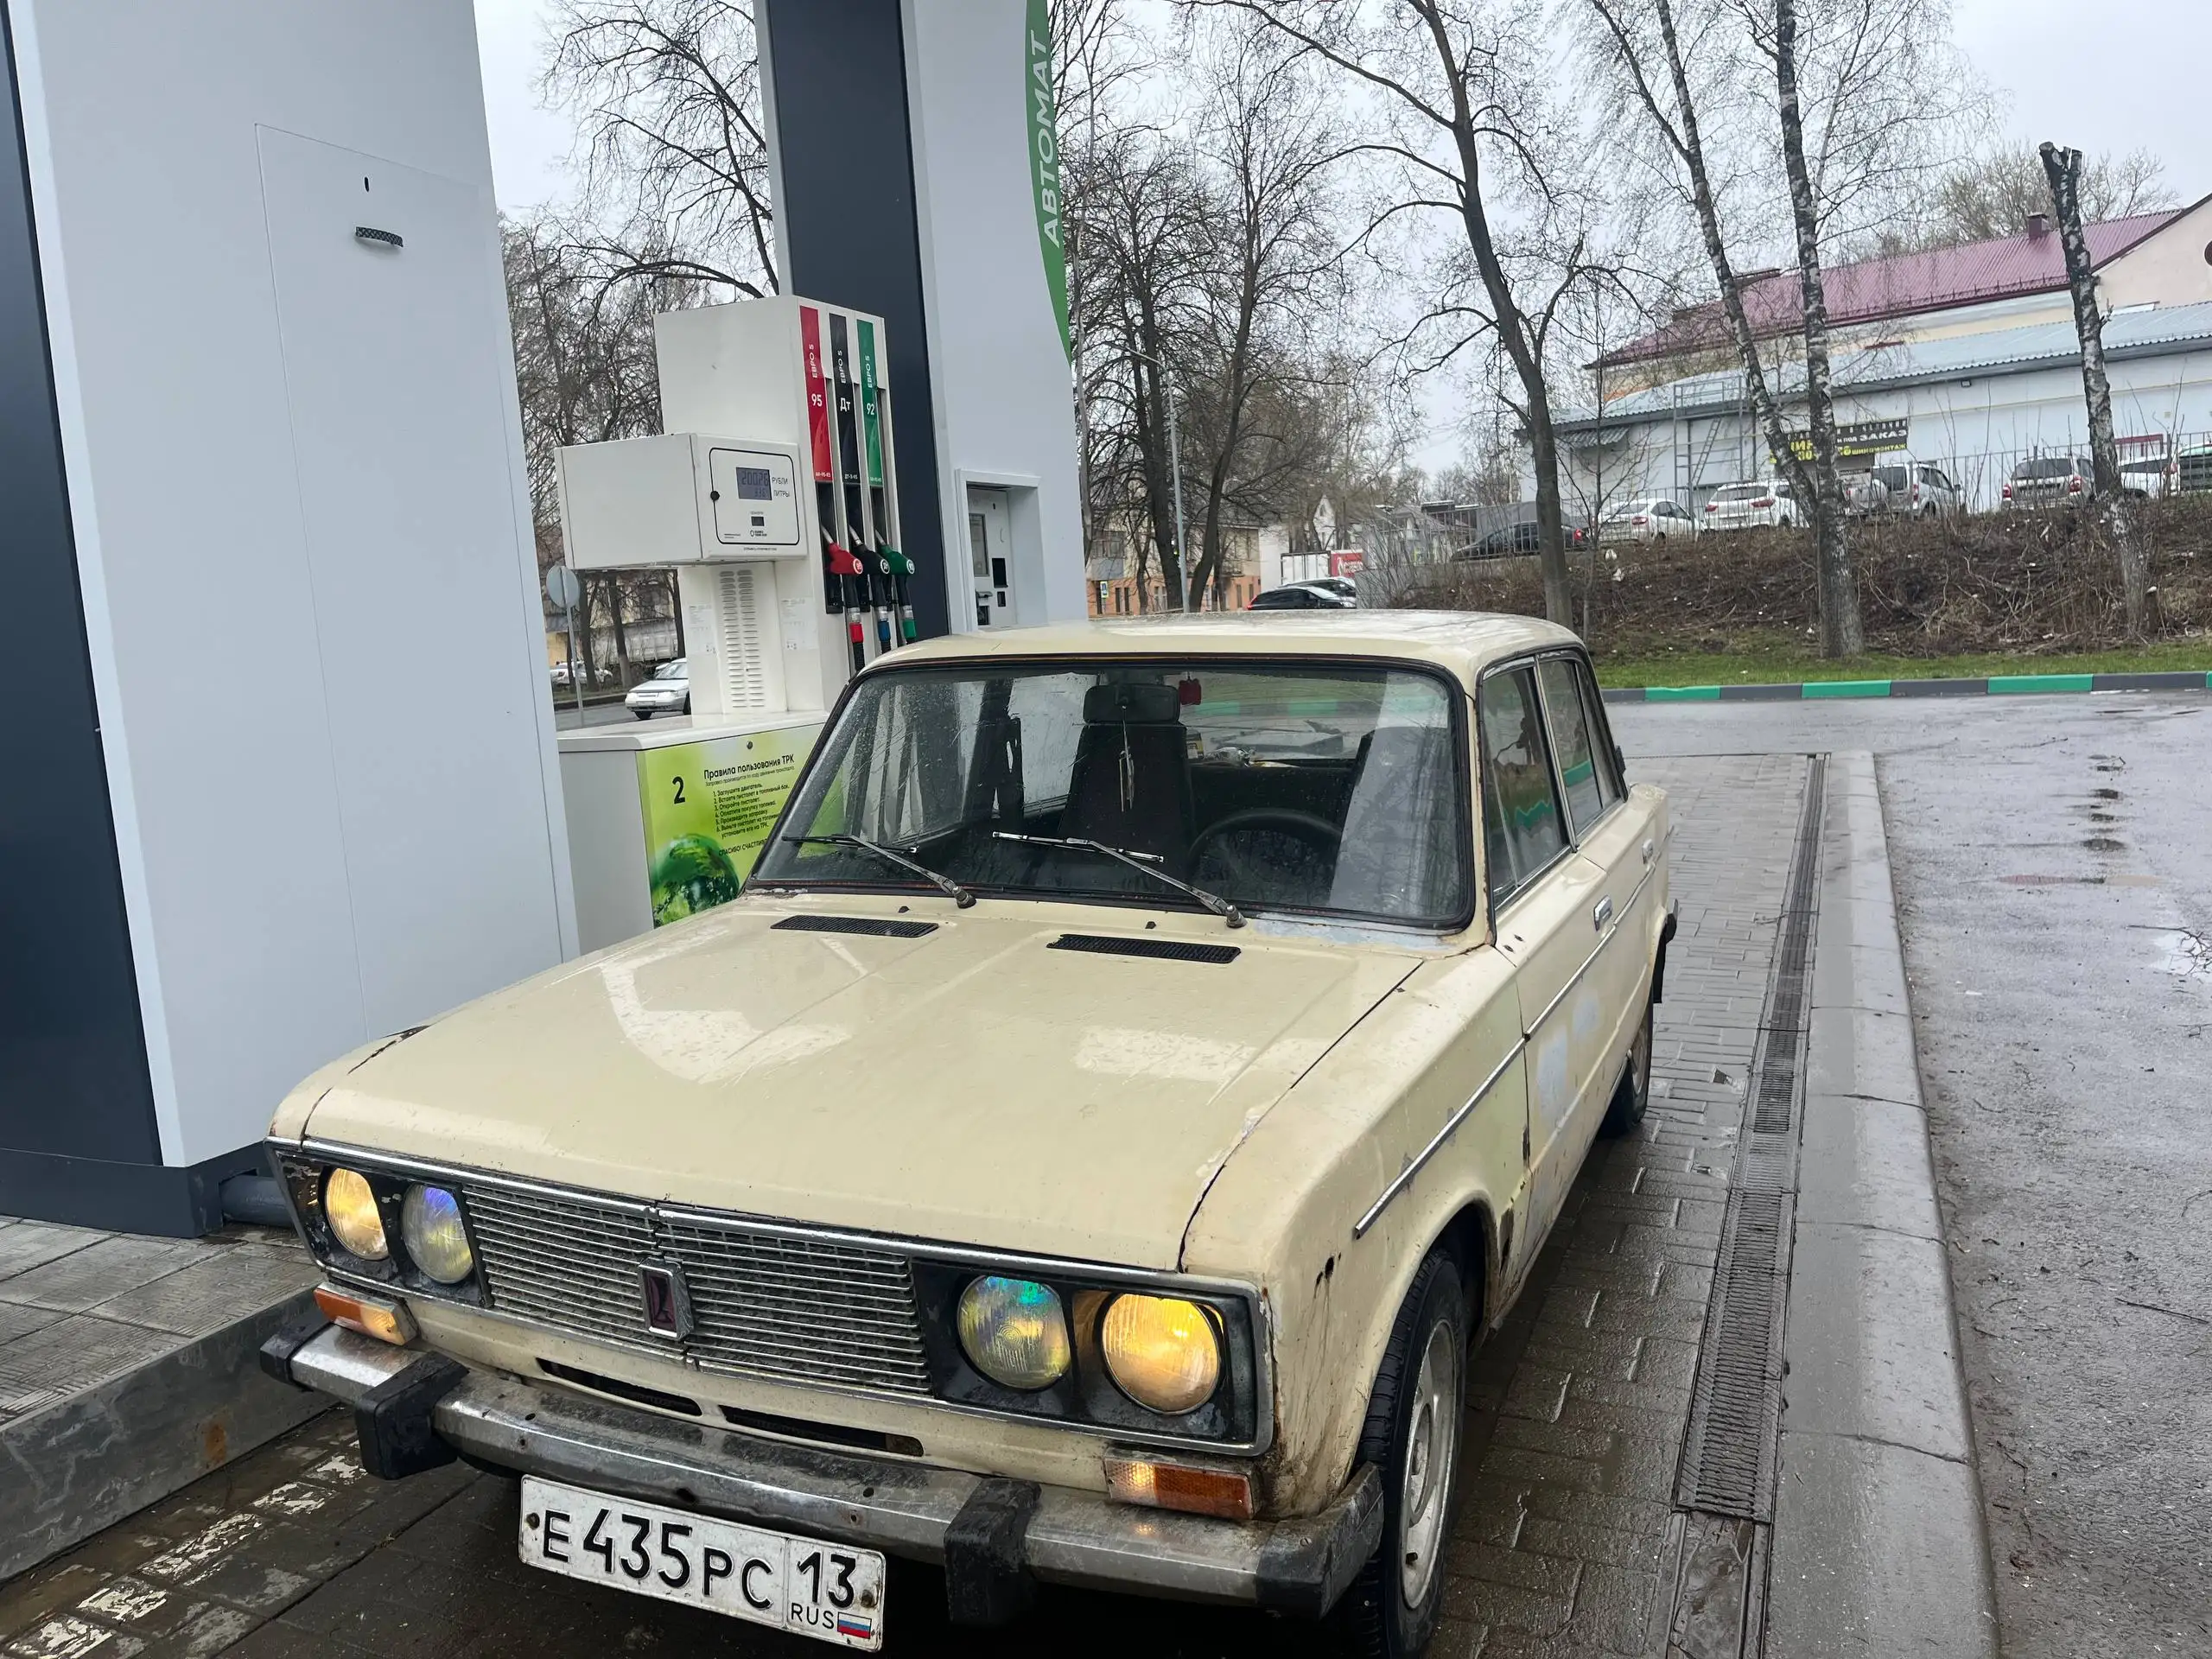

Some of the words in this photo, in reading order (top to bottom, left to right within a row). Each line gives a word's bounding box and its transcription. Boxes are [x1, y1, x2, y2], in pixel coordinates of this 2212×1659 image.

[1030, 29, 1060, 248] АВТОМАТ
[810, 353, 818, 378] ЕВРО
[838, 358, 847, 384] ЕВРО
[811, 393, 823, 407] 95
[867, 403, 875, 416] 92
[1859, 429, 1907, 442] ЗАКАЗ
[704, 766, 736, 781] Правила
[737, 759, 781, 773] пользования
[781, 753, 795, 766] ТРК
[672, 777, 685, 804] 2
[790, 1601, 835, 1630] RUS
